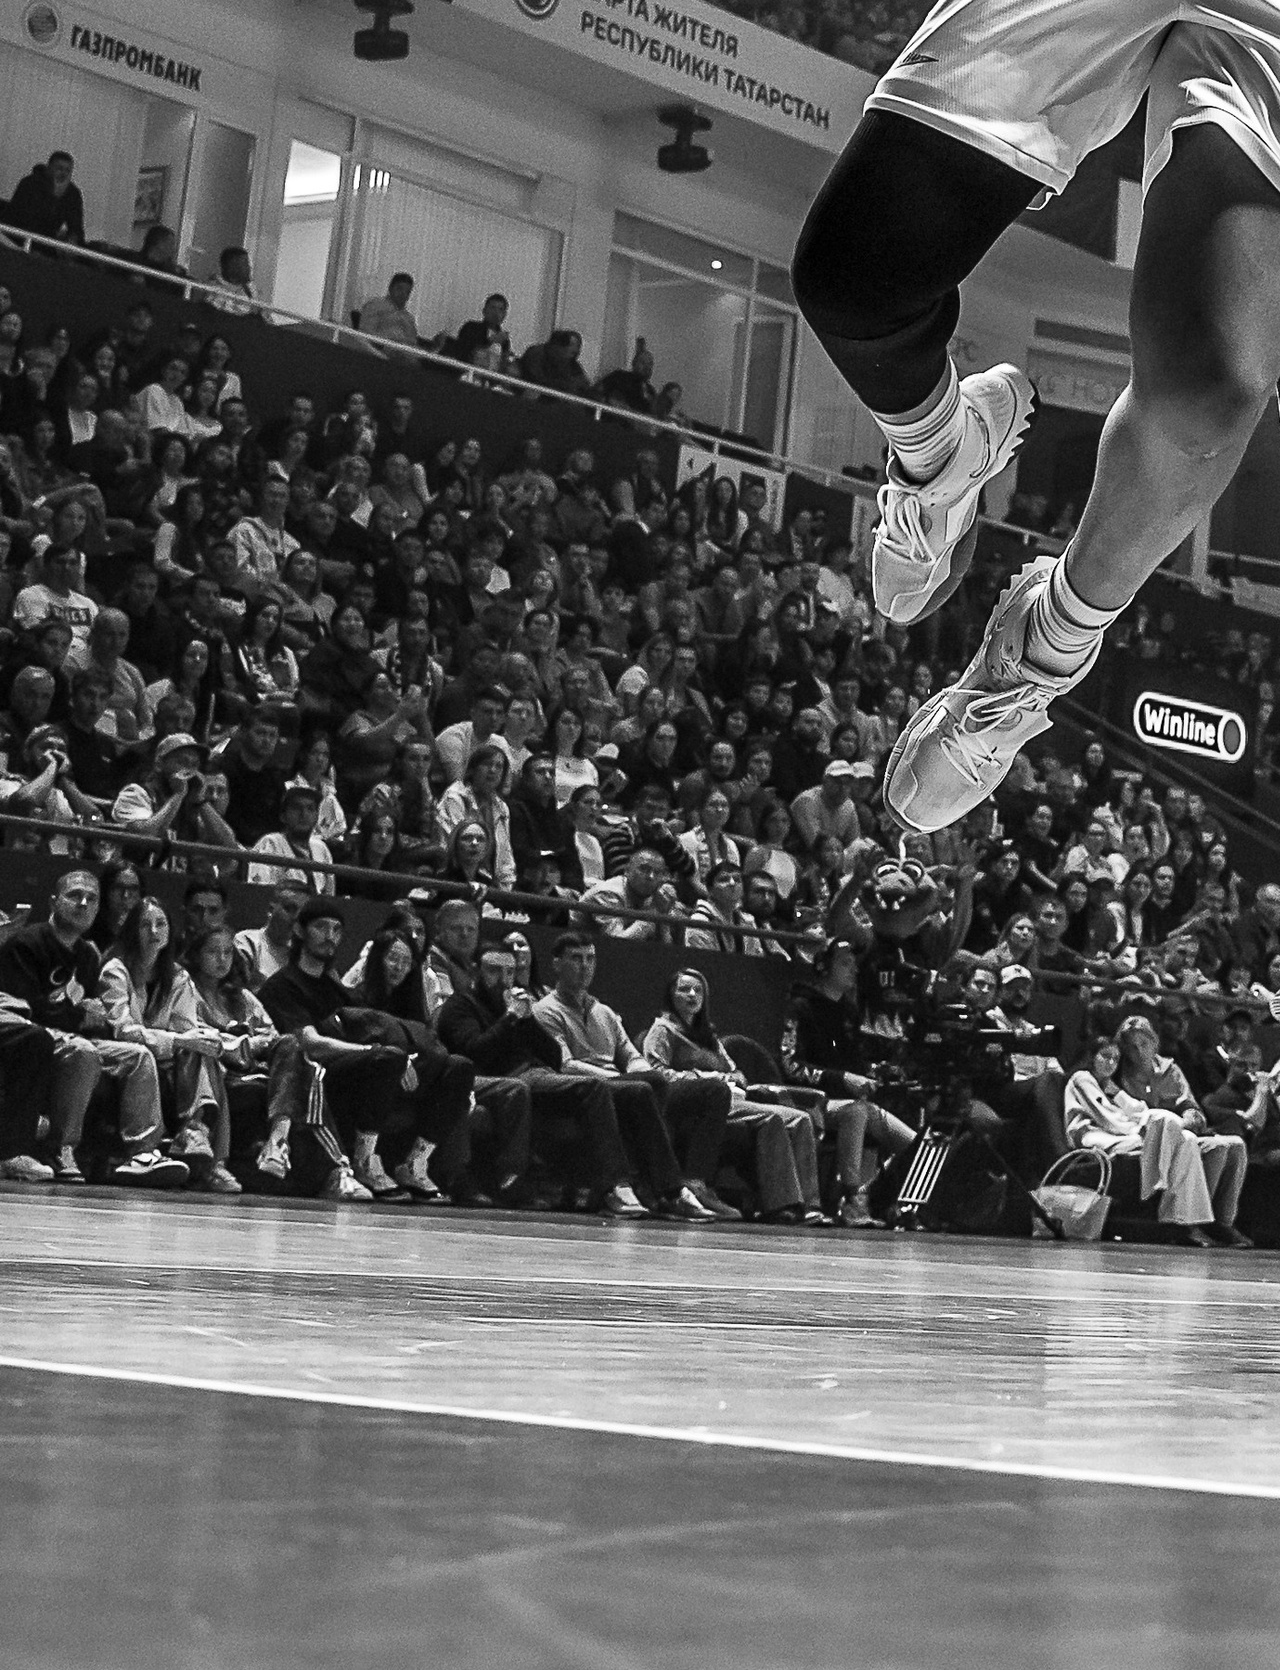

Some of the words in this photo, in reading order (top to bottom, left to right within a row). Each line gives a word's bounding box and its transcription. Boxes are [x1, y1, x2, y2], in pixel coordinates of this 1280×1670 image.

[70, 24, 202, 91] ГАЗПРОМБАНК
[653, 4, 739, 58] ЖИТЕЛЯ
[580, 10, 719, 86] РЕСПУБЛИКИ
[723, 68, 830, 130] ТАТАРСТАН
[1144, 703, 1216, 746] Winline
